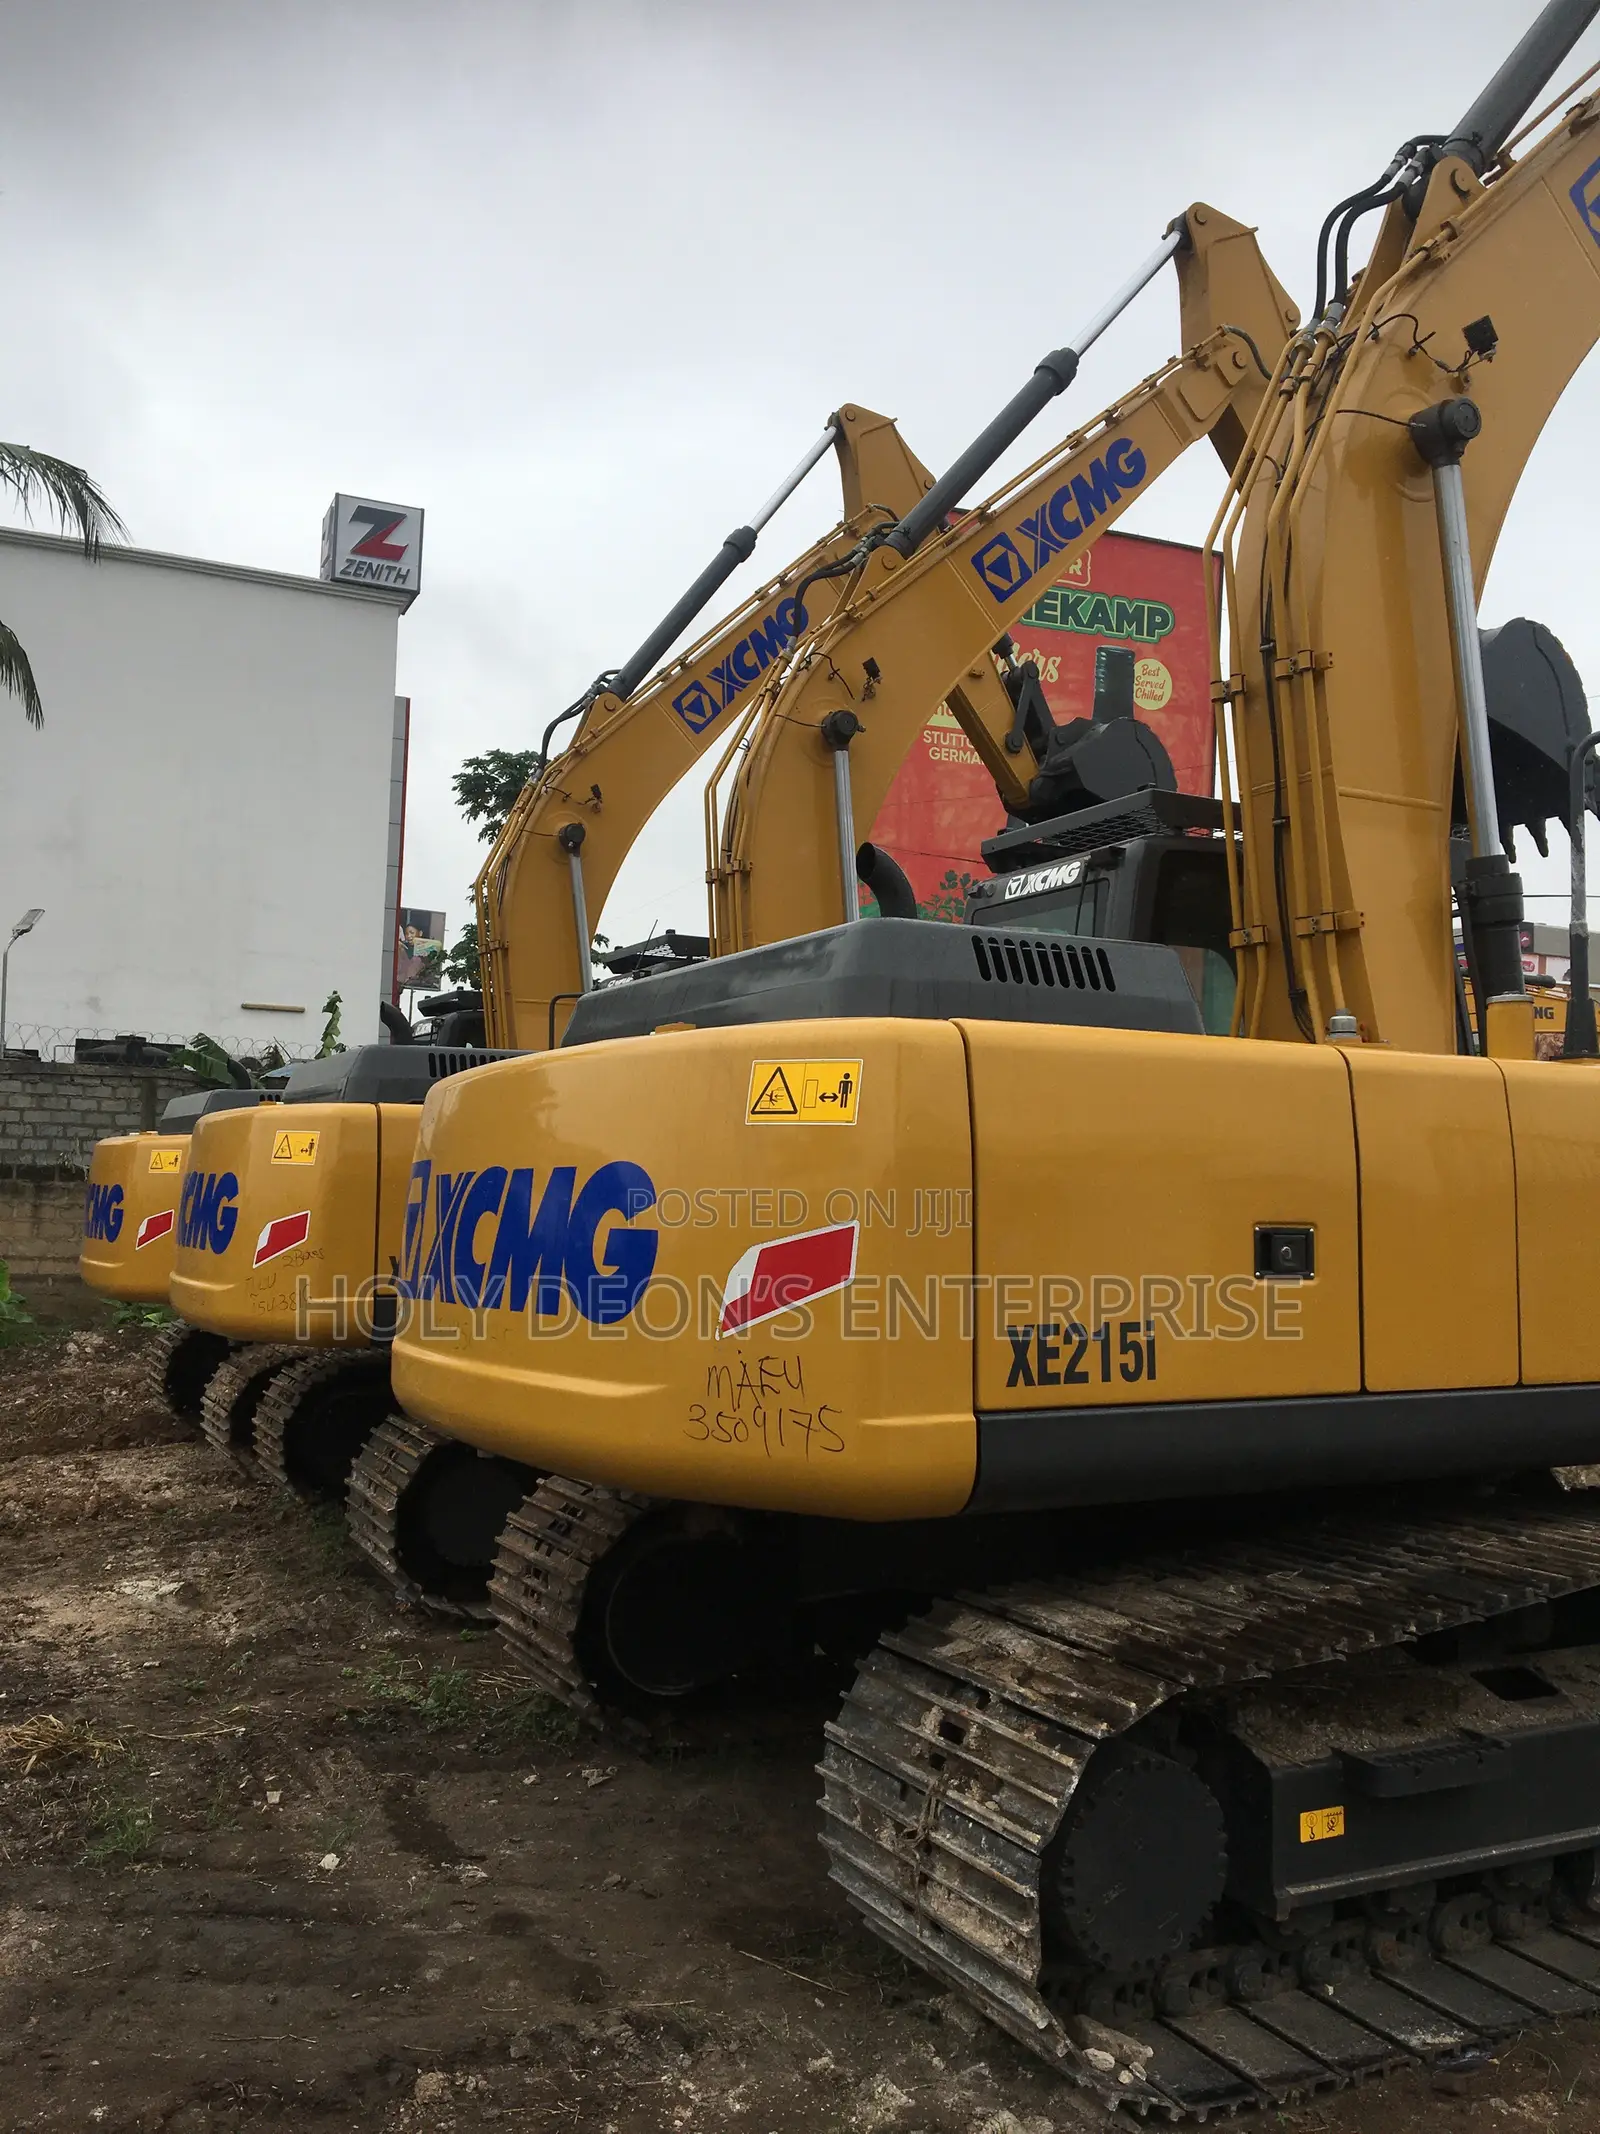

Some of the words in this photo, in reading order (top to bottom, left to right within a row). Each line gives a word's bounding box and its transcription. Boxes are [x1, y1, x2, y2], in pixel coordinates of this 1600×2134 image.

[1015, 438, 1147, 574] XCMG
[339, 558, 411, 585] ZENITH
[1135, 675, 1166, 690] Served
[1141, 664, 1161, 677] Best
[1135, 687, 1165, 702] Chilled
[929, 746, 985, 766] GERMA
[1020, 862, 1081, 896] XCMG
[415, 1161, 659, 1325] XCMG
[1006, 1319, 1157, 1388] XE215i
